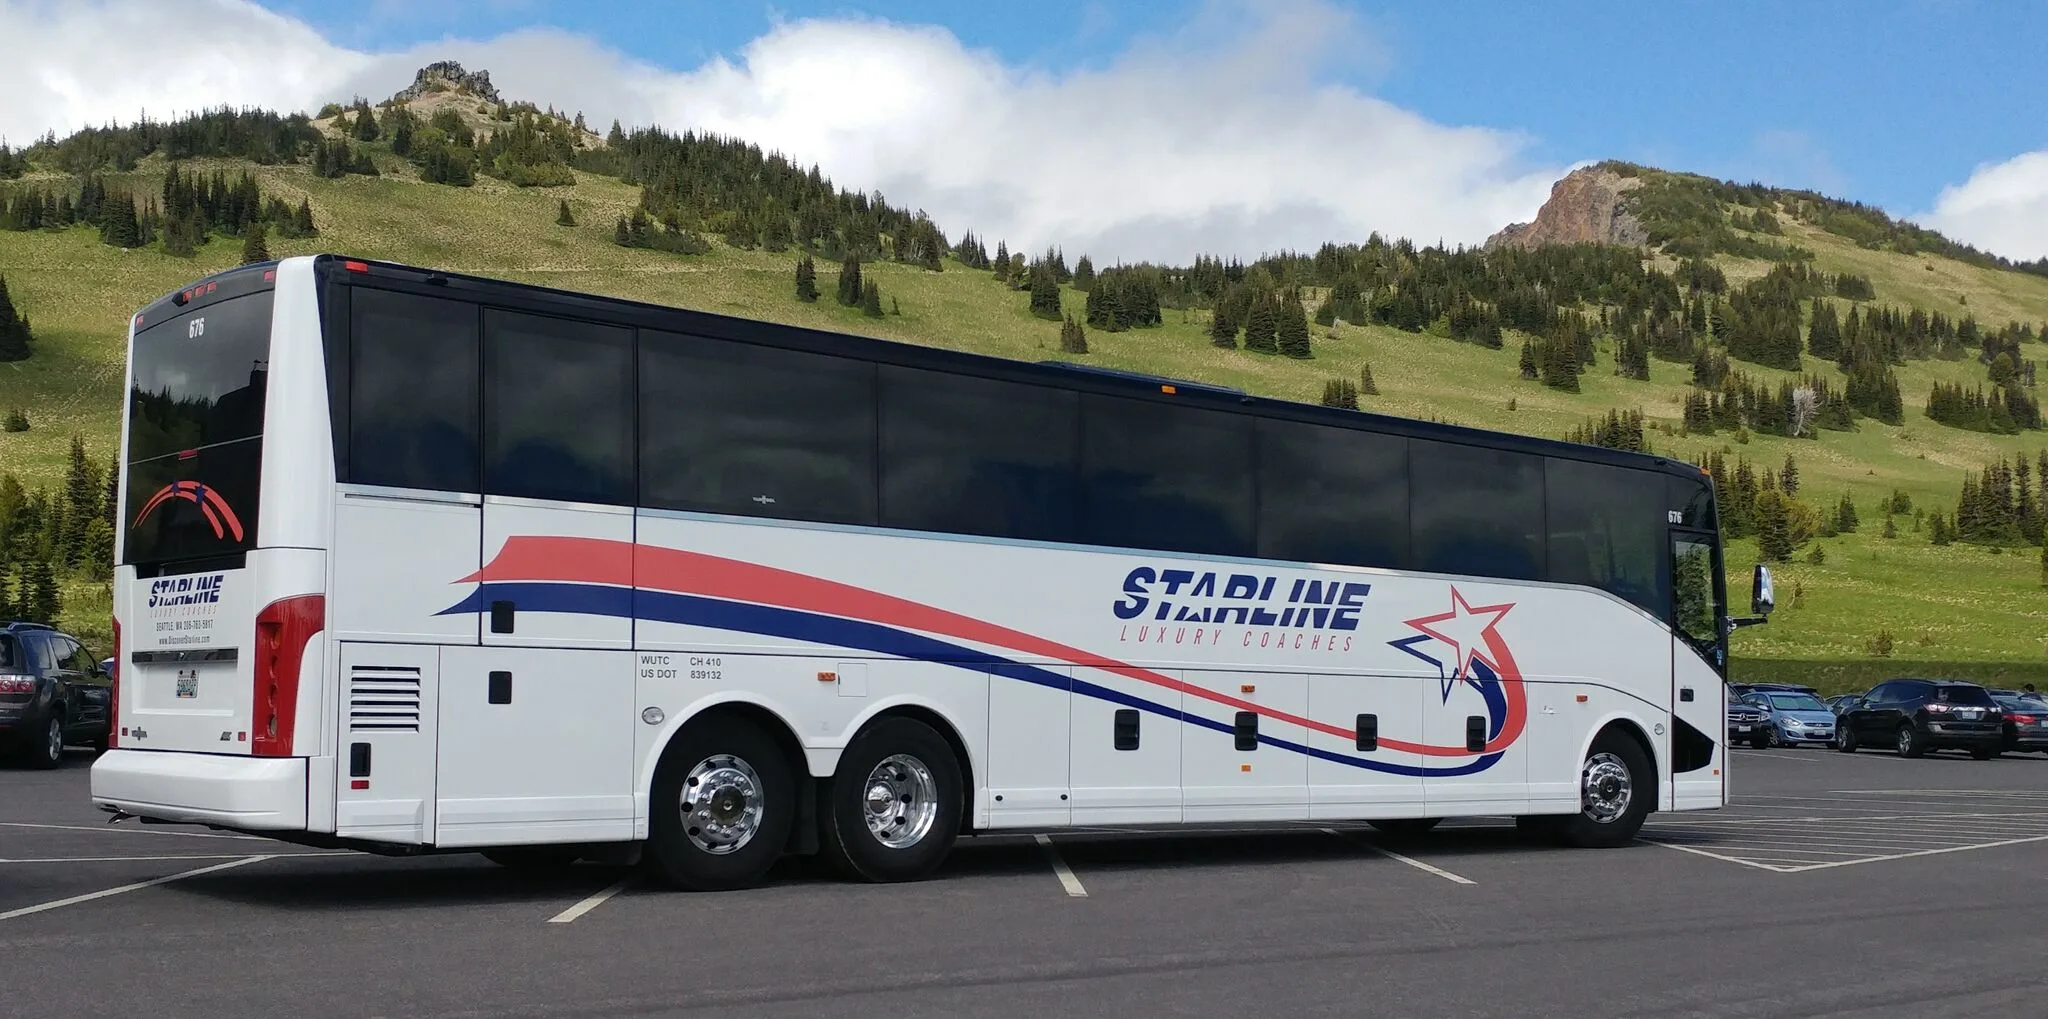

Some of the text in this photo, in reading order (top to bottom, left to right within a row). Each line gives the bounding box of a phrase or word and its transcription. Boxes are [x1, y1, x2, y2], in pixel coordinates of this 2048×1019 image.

[189, 317, 204, 339] 676
[1668, 510, 1682, 524] 676
[148, 575, 224, 608] STARLINE
[1113, 566, 1371, 631] STARLINE
[1120, 624, 1352, 652] LUXURY COACHES
[640, 655, 722, 667] WUTC CH 410
[640, 668, 722, 680] US DOT 839132
